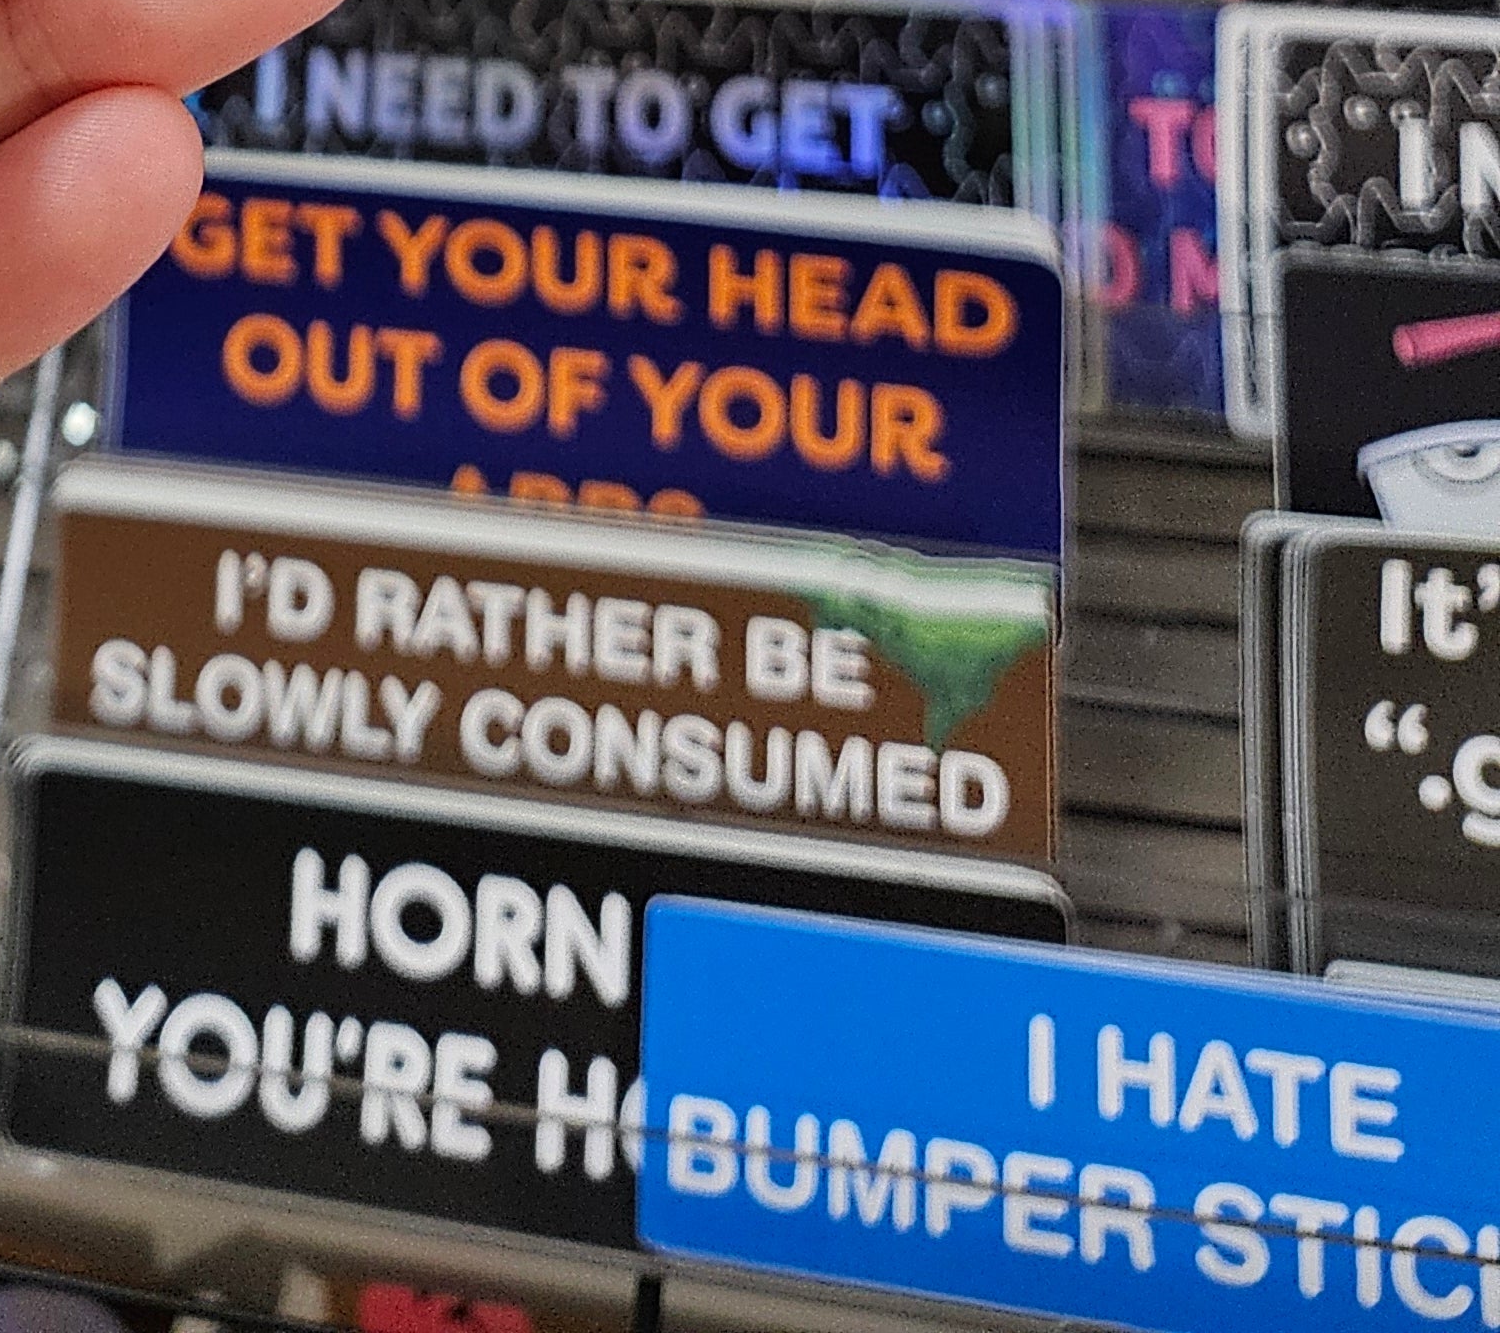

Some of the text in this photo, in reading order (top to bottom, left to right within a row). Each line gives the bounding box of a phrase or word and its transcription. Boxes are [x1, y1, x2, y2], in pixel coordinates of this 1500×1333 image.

[254, 43, 902, 183] I NEED TO GET
[167, 190, 364, 290] GET
[376, 205, 687, 326] YOUR
[706, 243, 1022, 359] HEAD
[221, 311, 953, 485] OUT OF YOUR
[214, 547, 878, 711] I'D RATHER BE
[90, 637, 1011, 839] SLOWLY CONSUMED
[288, 844, 635, 1009] HORN
[91, 976, 648, 1183] YOU'RE H
[1027, 1011, 1406, 1164] I HATE
[665, 1092, 1500, 1332] BUMPER STIC
